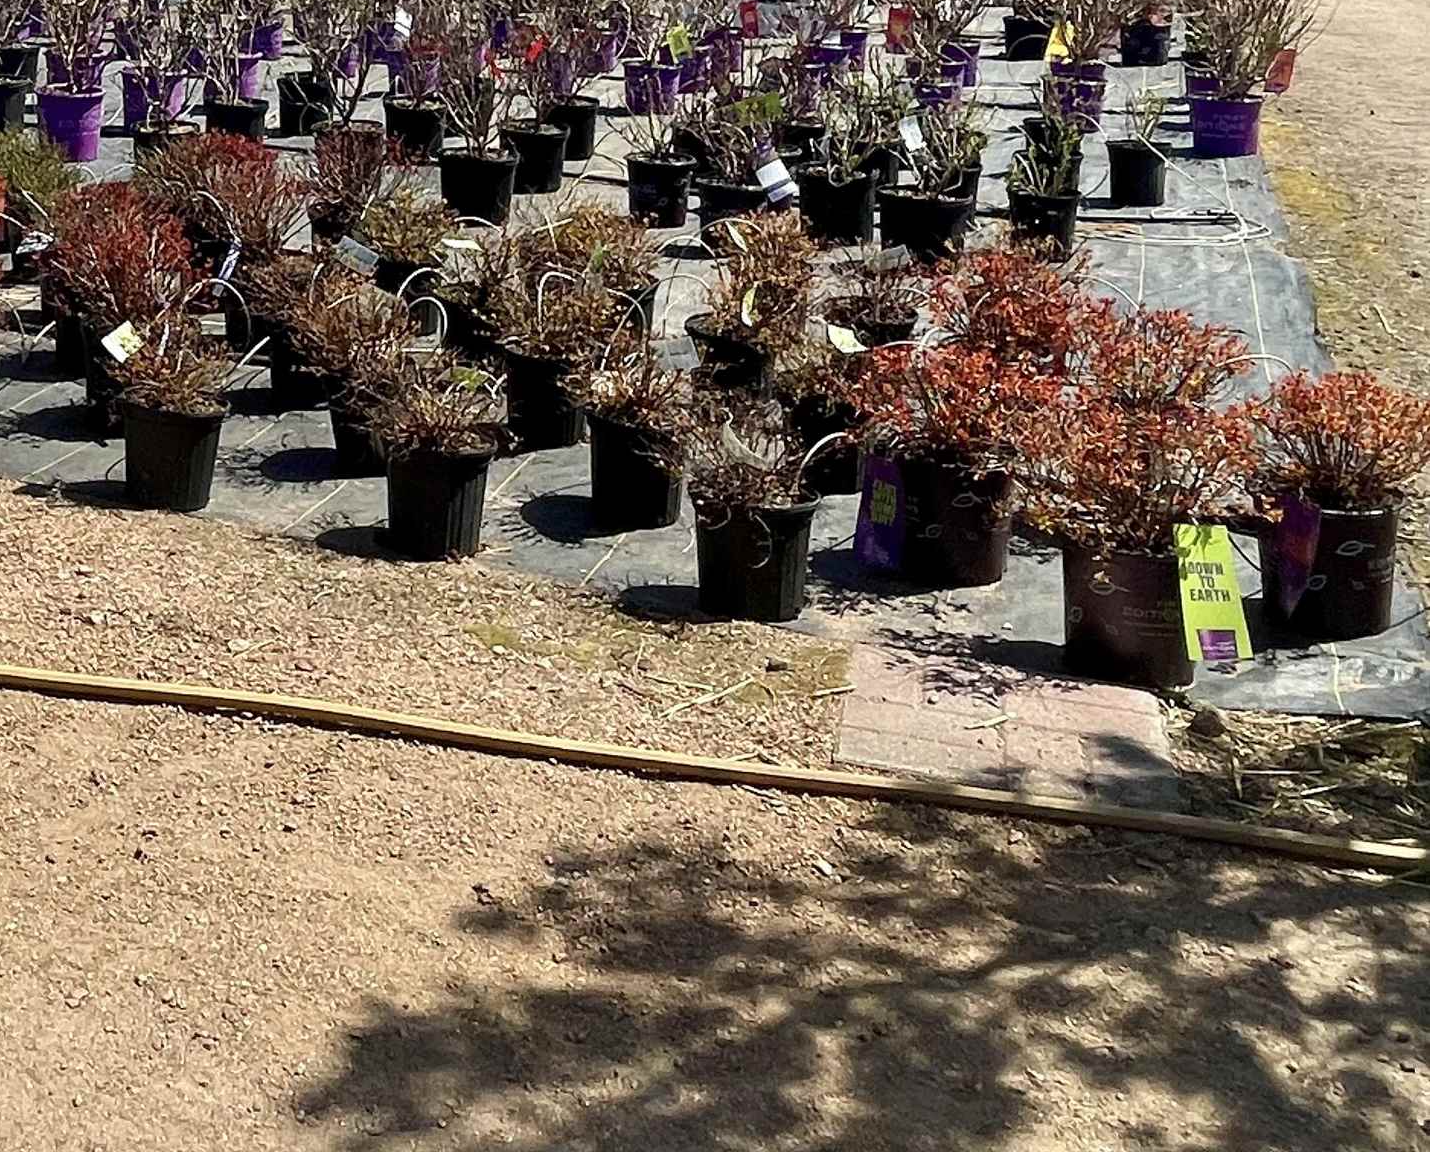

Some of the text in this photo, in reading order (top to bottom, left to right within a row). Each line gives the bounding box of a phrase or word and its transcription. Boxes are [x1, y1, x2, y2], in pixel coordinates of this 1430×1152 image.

[1188, 561, 1224, 576] DOWN
[1200, 576, 1216, 589] TO
[1190, 589, 1231, 602] EARTH
